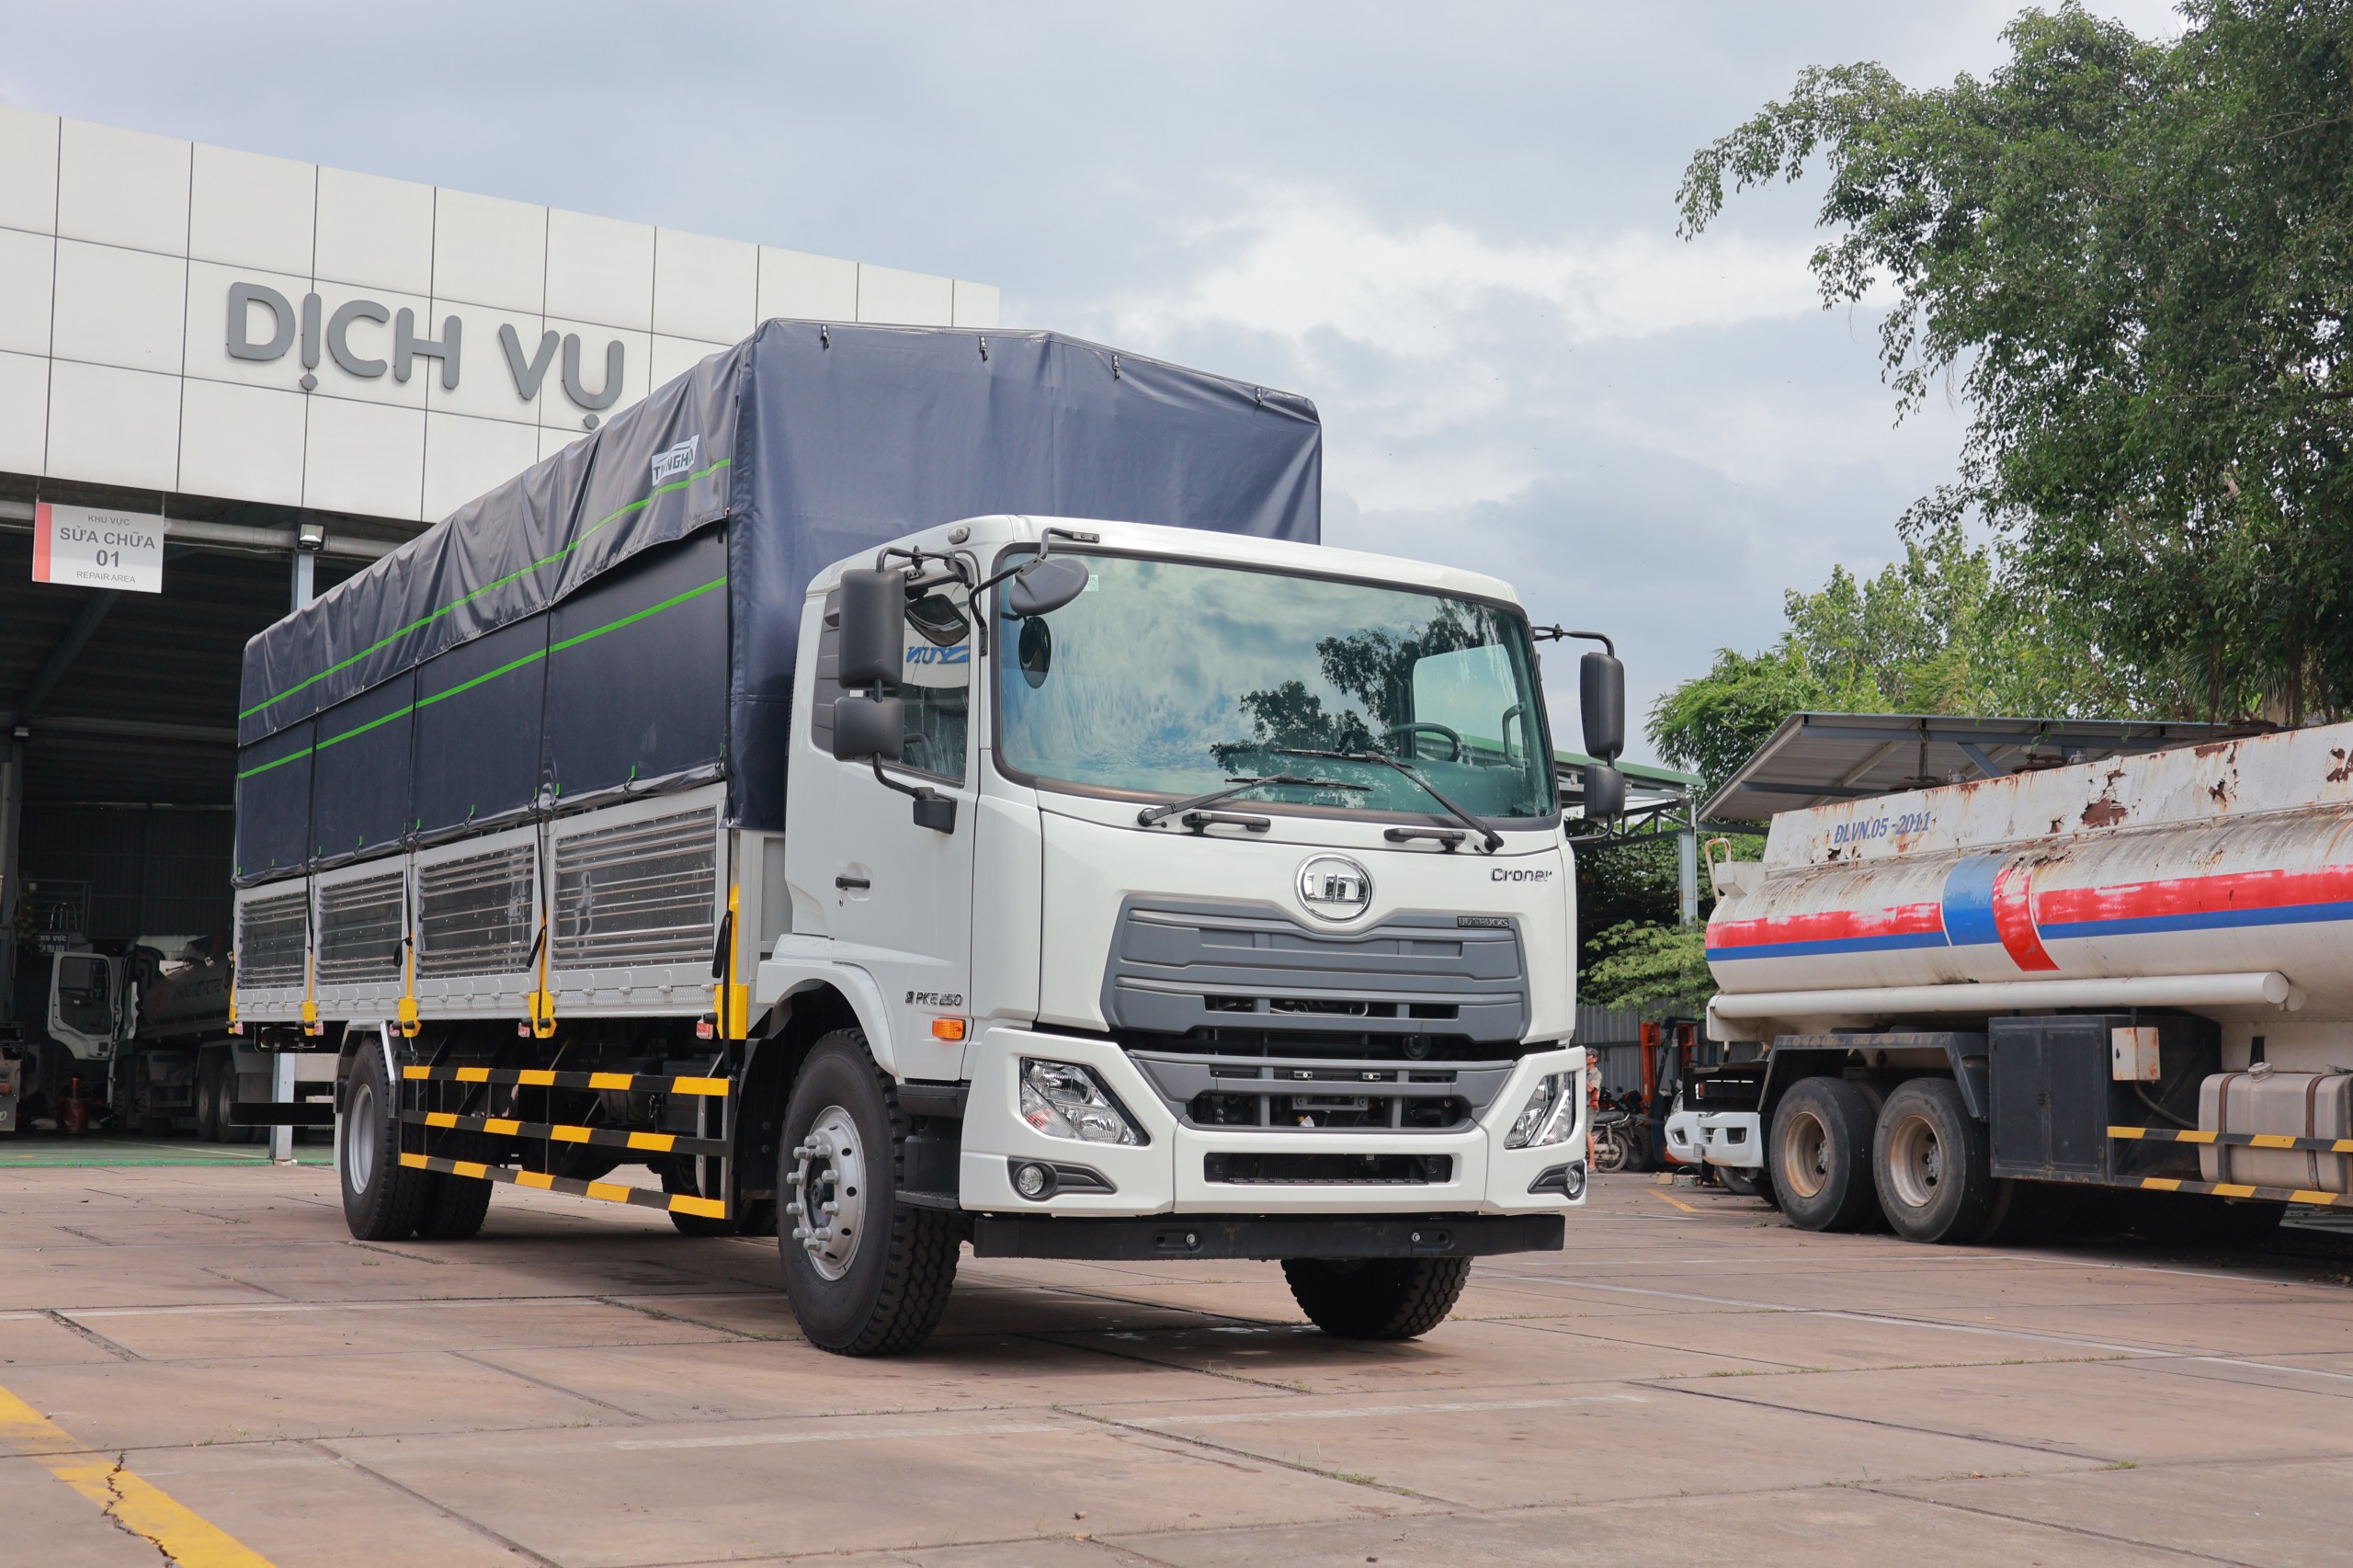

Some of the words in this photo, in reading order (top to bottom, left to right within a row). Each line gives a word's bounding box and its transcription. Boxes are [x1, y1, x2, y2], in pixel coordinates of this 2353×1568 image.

[226, 281, 462, 391] DỊCH
[498, 323, 625, 429] VỤ
[87, 515, 108, 524] KHU
[110, 516, 130, 527] VỰC
[60, 525, 98, 544] SỬA
[104, 531, 155, 550] CHỮA
[96, 550, 119, 568] 01
[76, 571, 109, 582] REPAIR
[111, 574, 136, 584] AREA
[1491, 868, 1552, 881] Croner
[916, 992, 938, 1006] PKE
[939, 993, 963, 1007] 250
